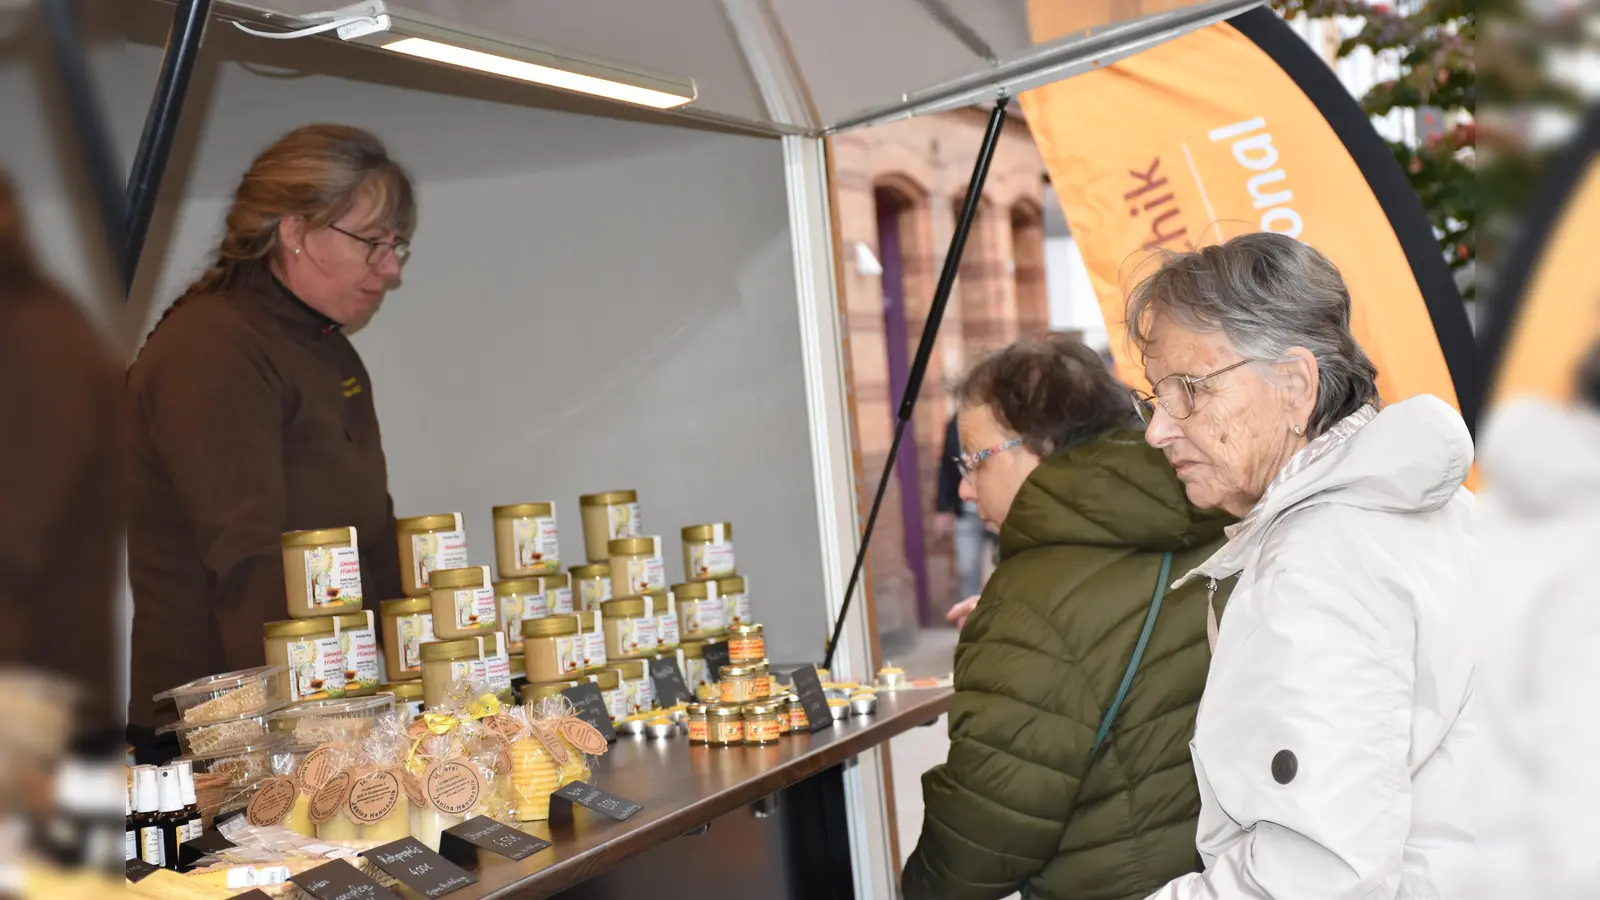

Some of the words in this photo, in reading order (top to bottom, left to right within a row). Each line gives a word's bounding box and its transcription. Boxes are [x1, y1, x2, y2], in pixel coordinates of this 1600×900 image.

[1124, 157, 1191, 250] hik
[1208, 117, 1306, 242] onal
[351, 802, 368, 818] Janina
[433, 796, 454, 811] Janina
